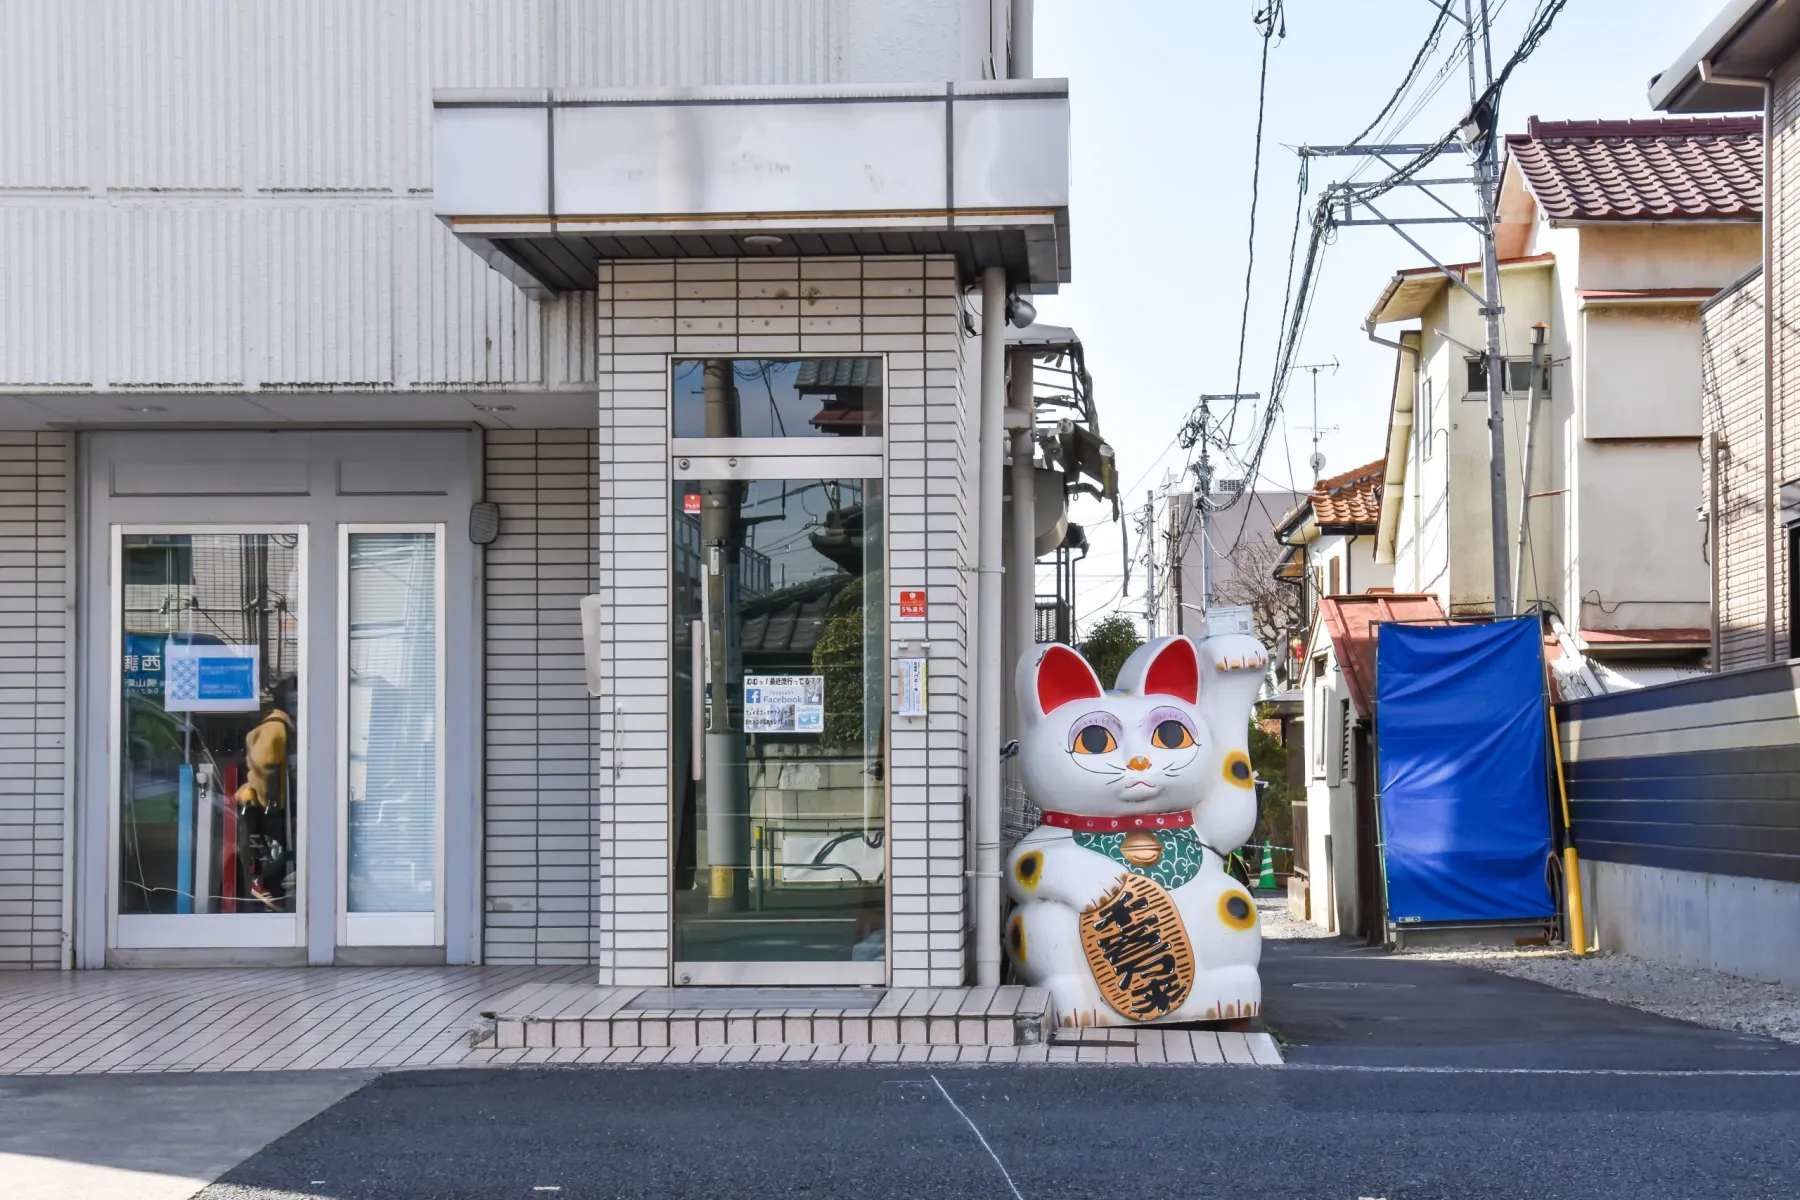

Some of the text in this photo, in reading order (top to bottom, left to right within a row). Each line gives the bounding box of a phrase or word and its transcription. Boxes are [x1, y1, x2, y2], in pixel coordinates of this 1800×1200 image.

[763, 695, 803, 704] Facebook
[1092, 891, 1187, 1014] 千客万来
